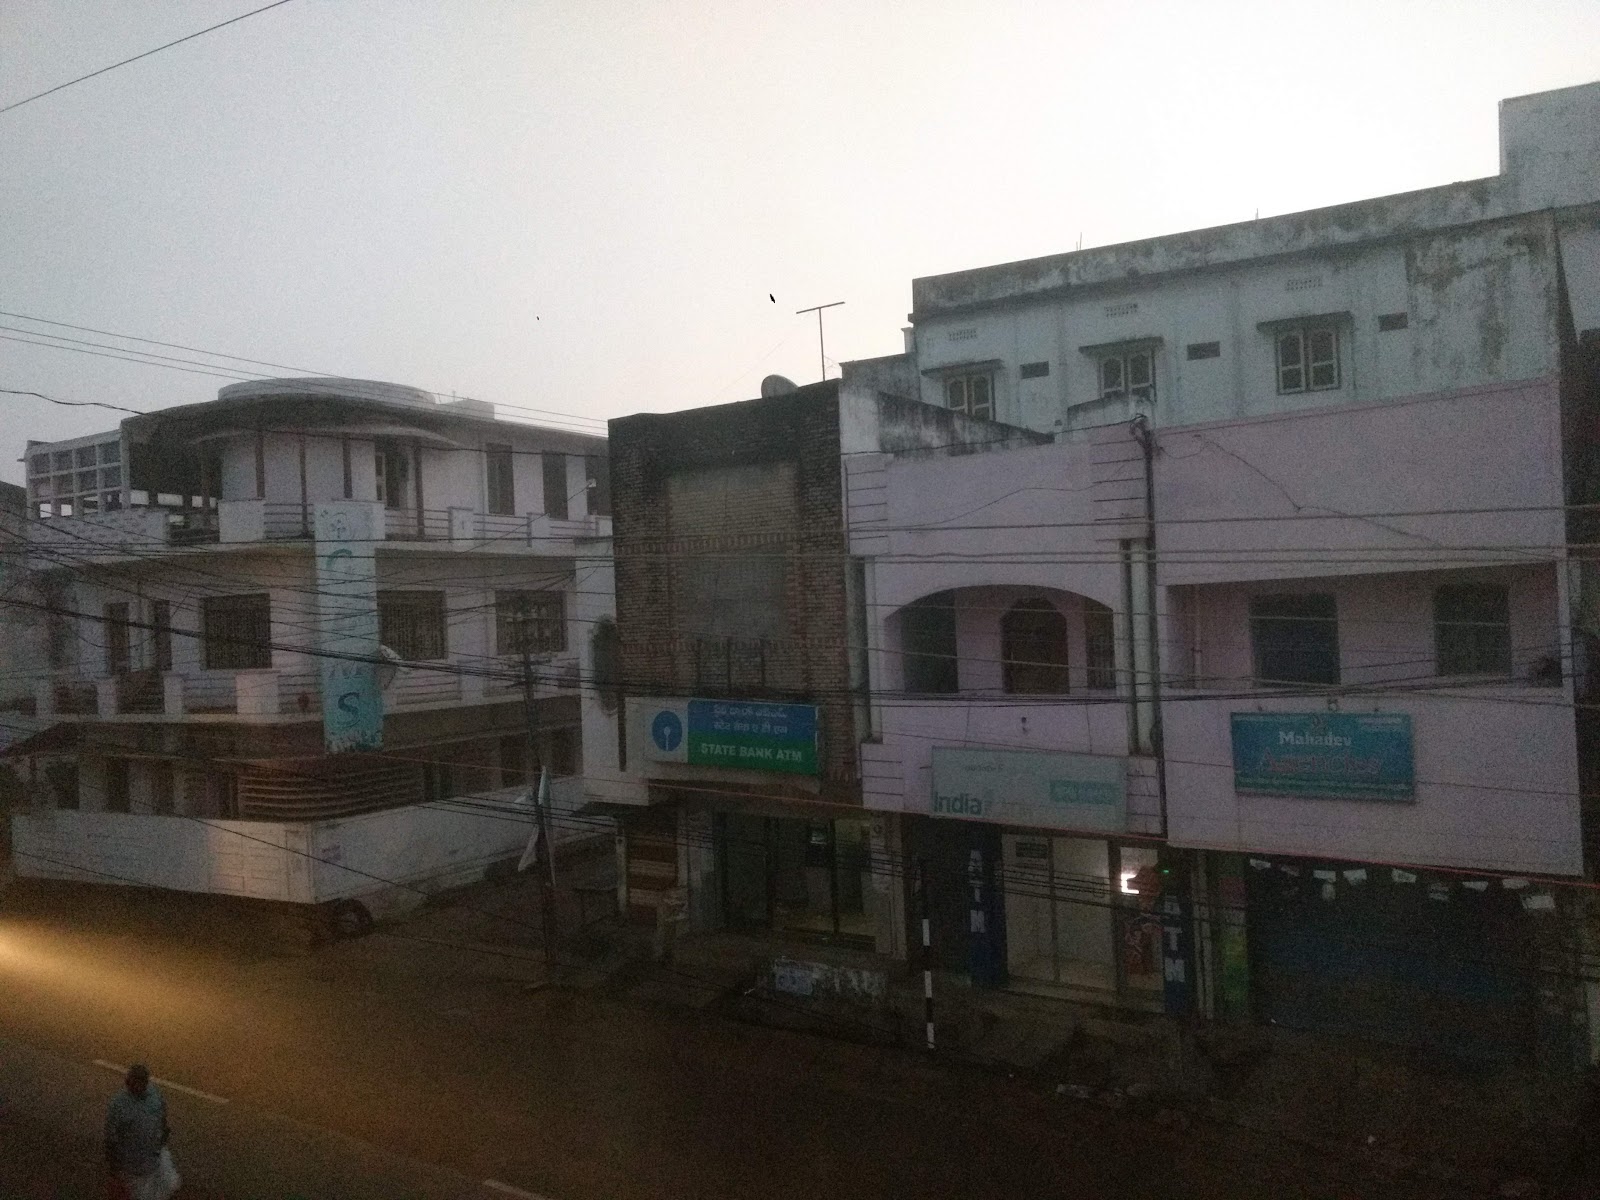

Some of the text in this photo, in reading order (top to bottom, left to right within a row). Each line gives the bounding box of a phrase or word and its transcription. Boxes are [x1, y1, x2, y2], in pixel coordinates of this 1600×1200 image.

[1278, 730, 1353, 747] Mahadev
[700, 742, 803, 762] STATE BANK ATM
[933, 791, 983, 815] India
[967, 849, 986, 934] ATM
